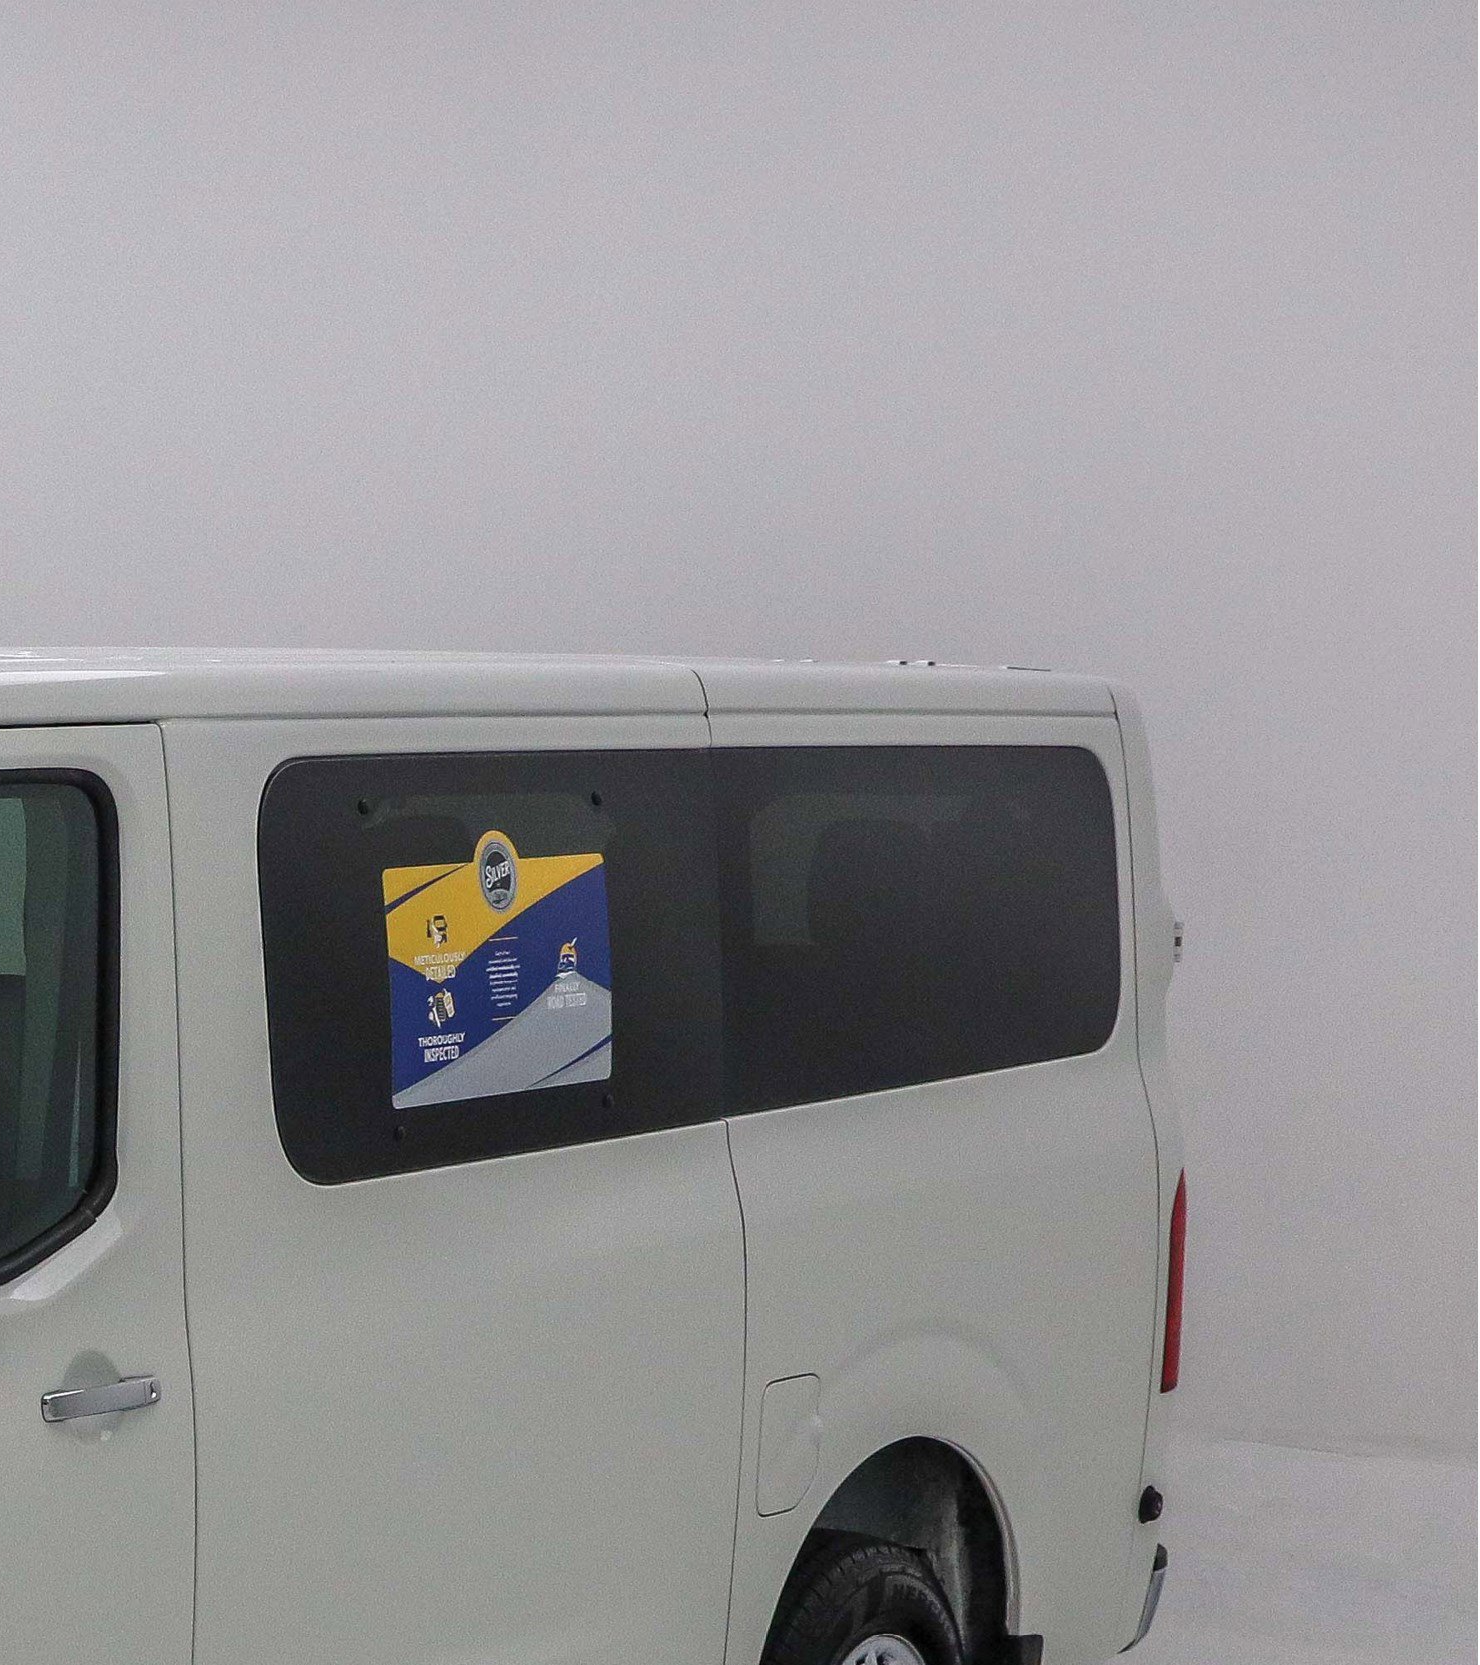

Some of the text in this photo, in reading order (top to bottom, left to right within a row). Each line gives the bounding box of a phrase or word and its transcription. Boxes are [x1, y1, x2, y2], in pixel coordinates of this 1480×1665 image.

[485, 860, 511, 889] SILVER
[418, 1032, 466, 1047] THOROUGHLY
[424, 1045, 460, 1063] INSPECTED
